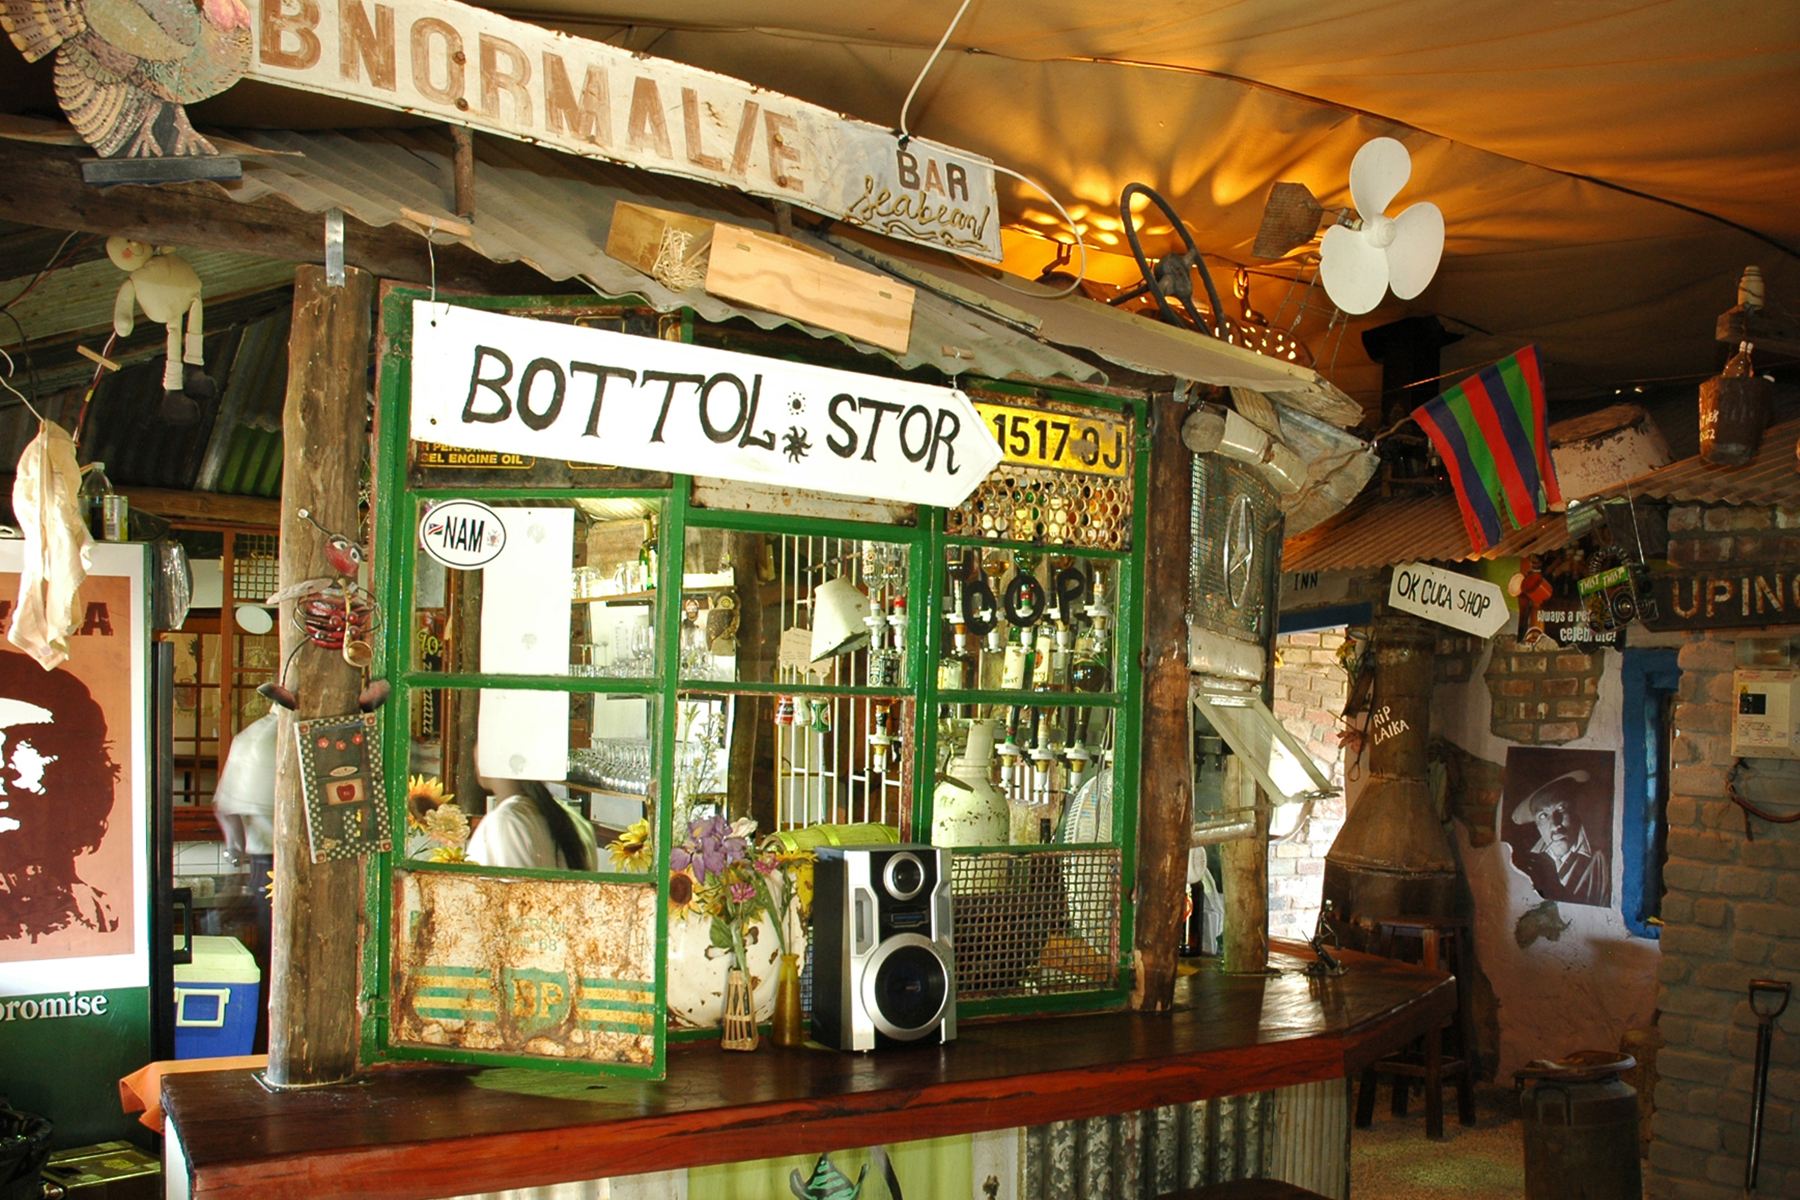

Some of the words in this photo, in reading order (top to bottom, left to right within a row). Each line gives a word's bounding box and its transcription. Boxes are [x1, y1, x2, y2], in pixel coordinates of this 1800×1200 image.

[897, 149, 969, 202] BAR
[461, 344, 777, 450] BOTTOL
[827, 392, 962, 476] STOR
[449, 453, 498, 465] ENGINE
[501, 454, 523, 466] OIL
[442, 515, 485, 553] NAM
[1293, 570, 1319, 591] INN
[1397, 571, 1421, 602] OK
[1420, 578, 1453, 611] CUCA
[1456, 588, 1491, 619] SHOP
[1567, 611, 1574, 623] a
[1373, 719, 1410, 746] LAIKA
[512, 979, 565, 1019] BP
